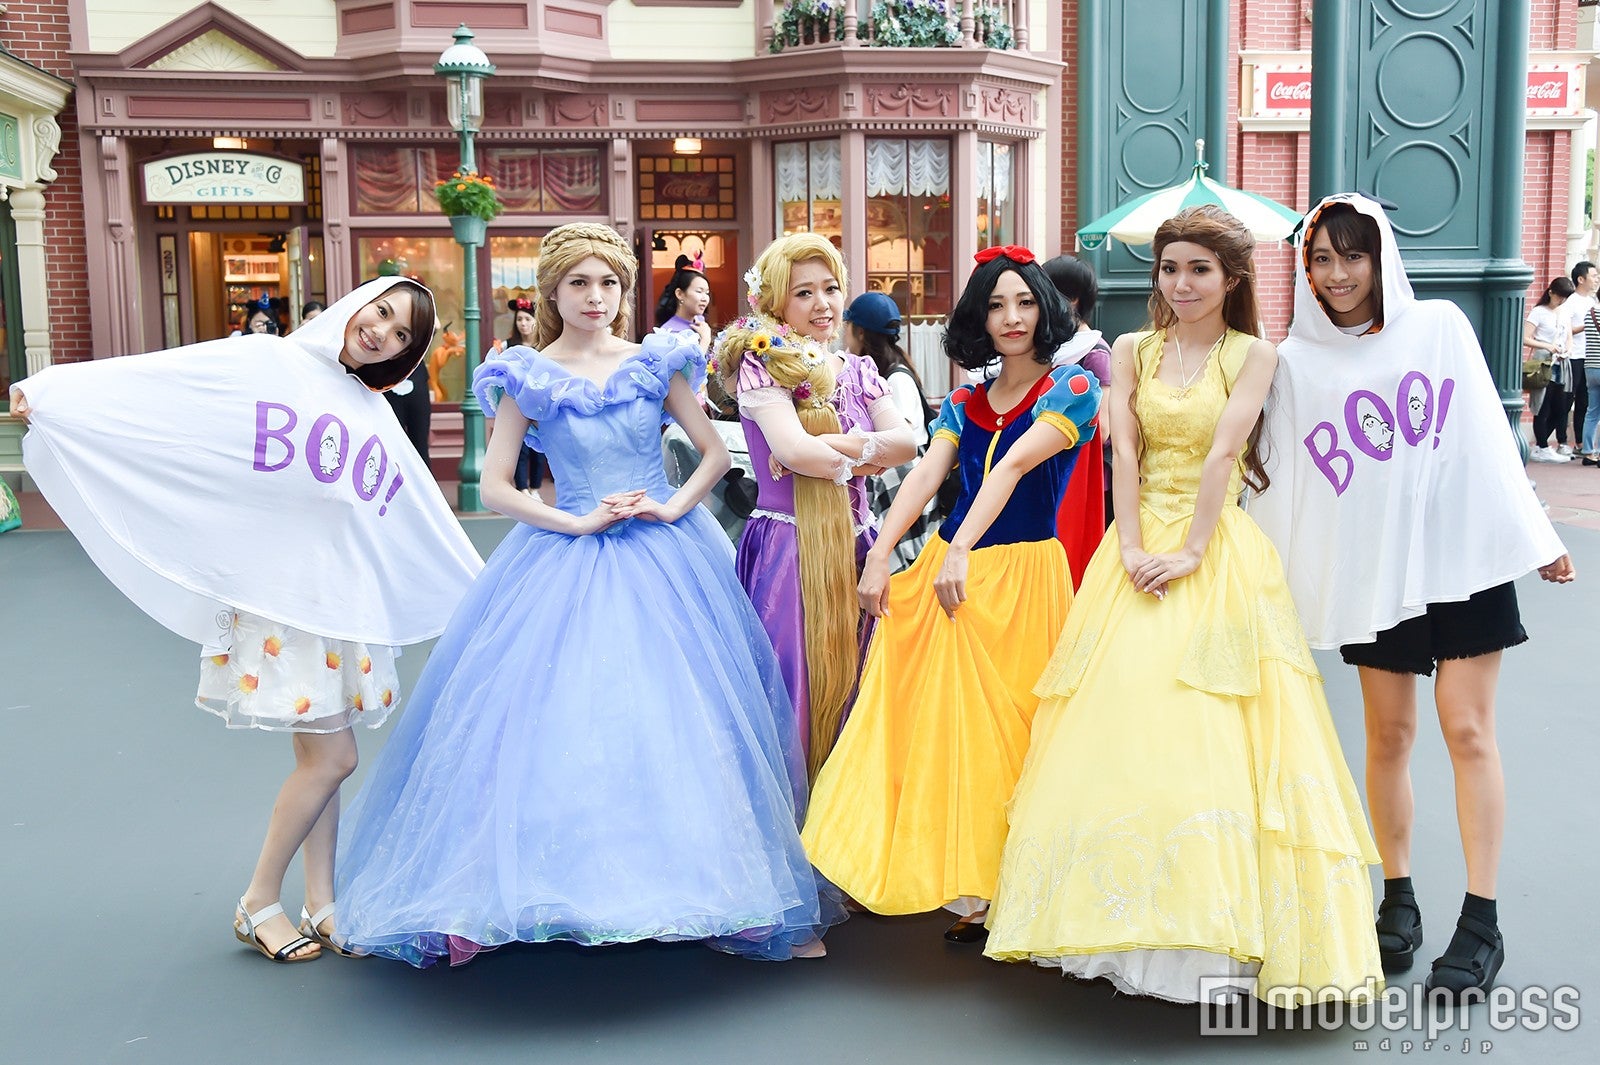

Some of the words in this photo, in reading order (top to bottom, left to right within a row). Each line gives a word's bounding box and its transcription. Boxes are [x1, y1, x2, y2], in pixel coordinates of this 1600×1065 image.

[165, 159, 250, 186] DISNEY
[196, 186, 254, 197] GIFTS
[253, 400, 404, 517] BOO!
[1303, 370, 1455, 498] BOO!
